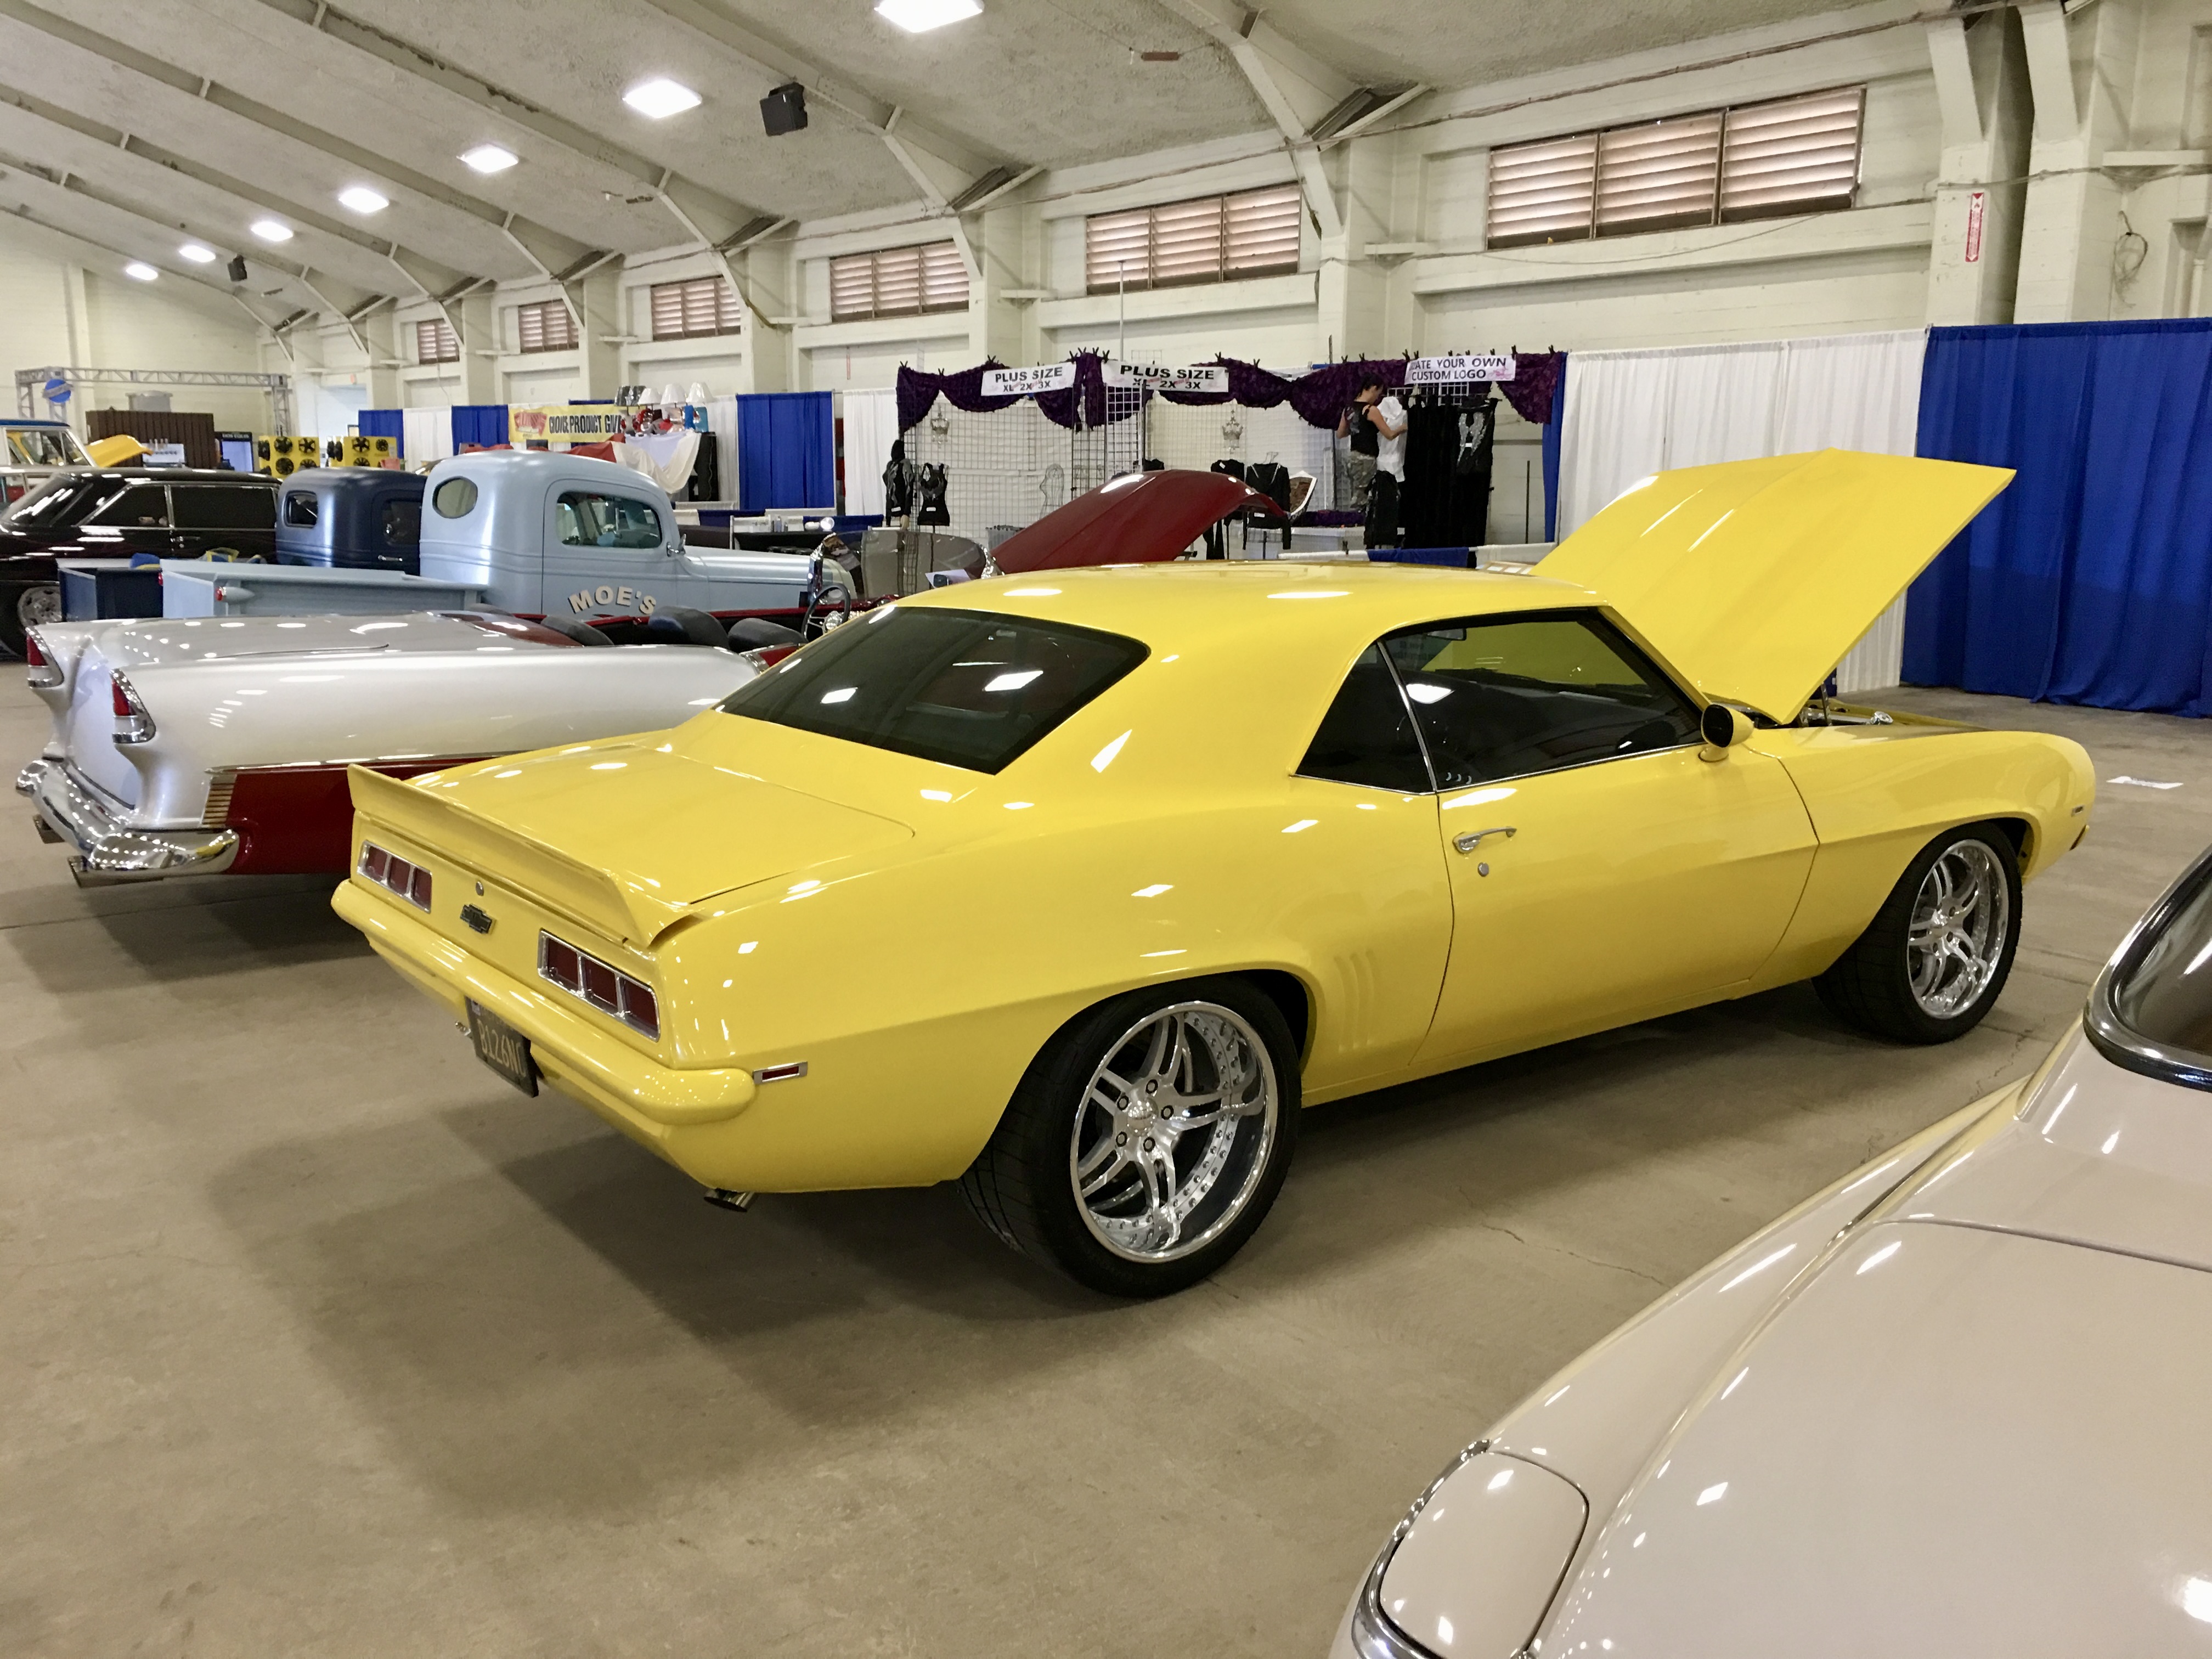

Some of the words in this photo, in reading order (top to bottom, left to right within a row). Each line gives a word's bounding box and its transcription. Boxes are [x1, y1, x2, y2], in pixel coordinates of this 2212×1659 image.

[1410, 360, 1431, 370] ATE
[1437, 358, 1465, 369] YOUR
[1472, 357, 1506, 368] OWN
[995, 371, 1027, 383] PLUS
[1032, 366, 1063, 380] SIZE
[1120, 365, 1171, 378] PLUS
[1177, 369, 1214, 380] SIZE
[1412, 370, 1451, 381] CUSTOM
[1454, 369, 1486, 379] LOGO
[1038, 380, 1051, 389] 3X
[1185, 381, 1201, 390] 3X
[569, 415, 602, 434] PRODUCT
[568, 585, 657, 614] MOE'S
